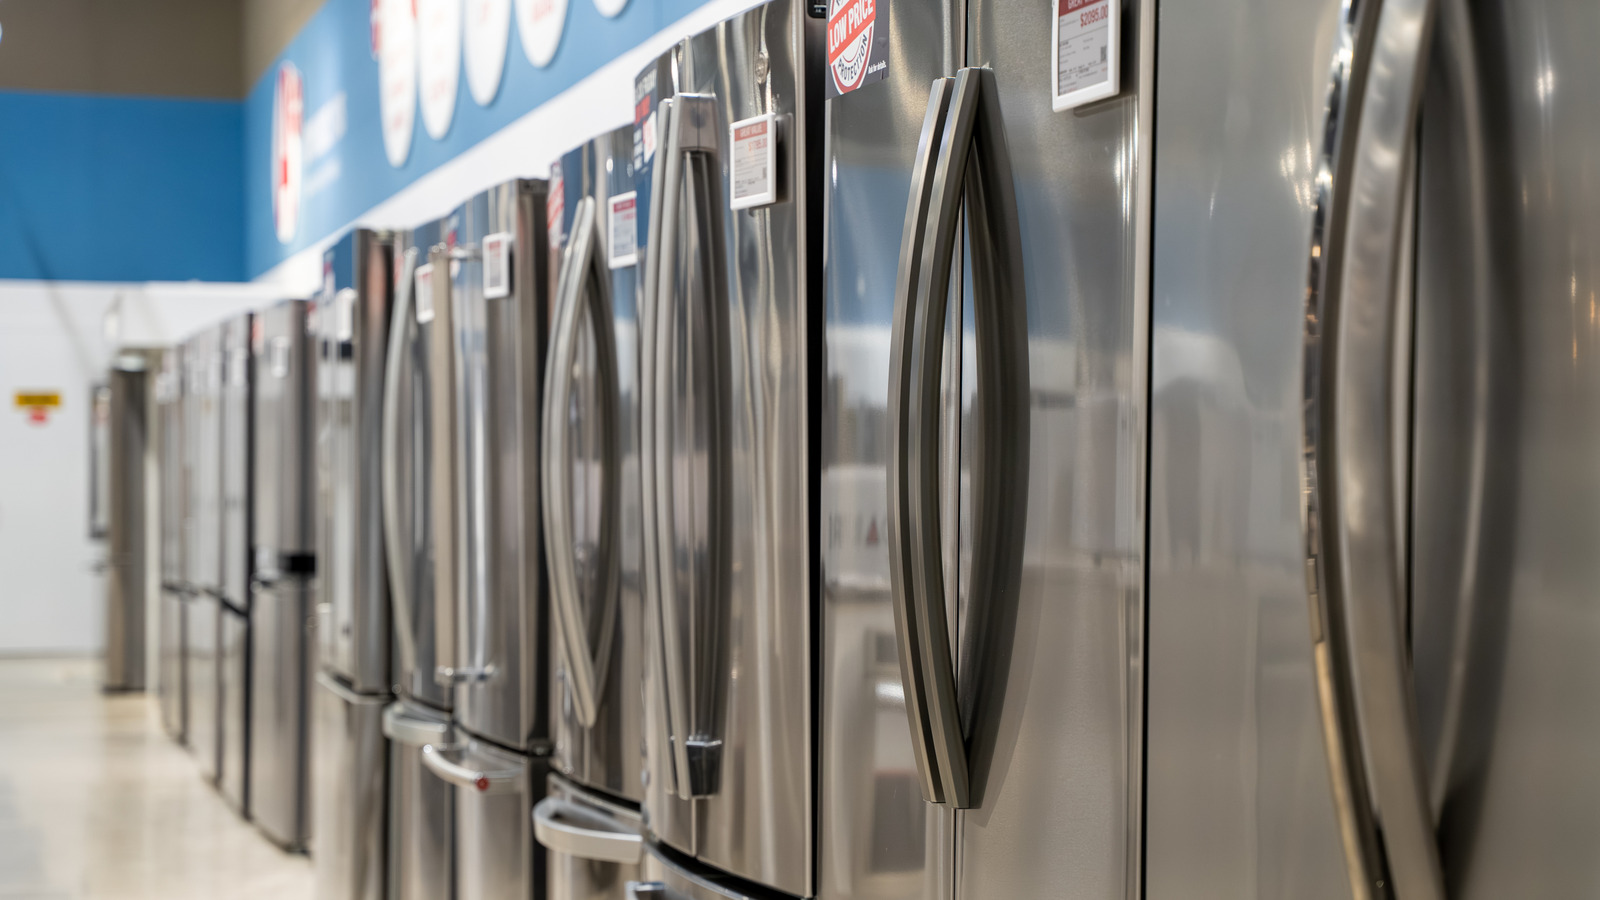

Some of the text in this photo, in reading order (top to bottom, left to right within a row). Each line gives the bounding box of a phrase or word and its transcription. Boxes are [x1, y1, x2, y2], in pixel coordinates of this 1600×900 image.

[830, 0, 874, 54] LOW PRICE
[1080, 4, 1108, 28] $2095.00
[837, 34, 868, 81] PROTECTION
